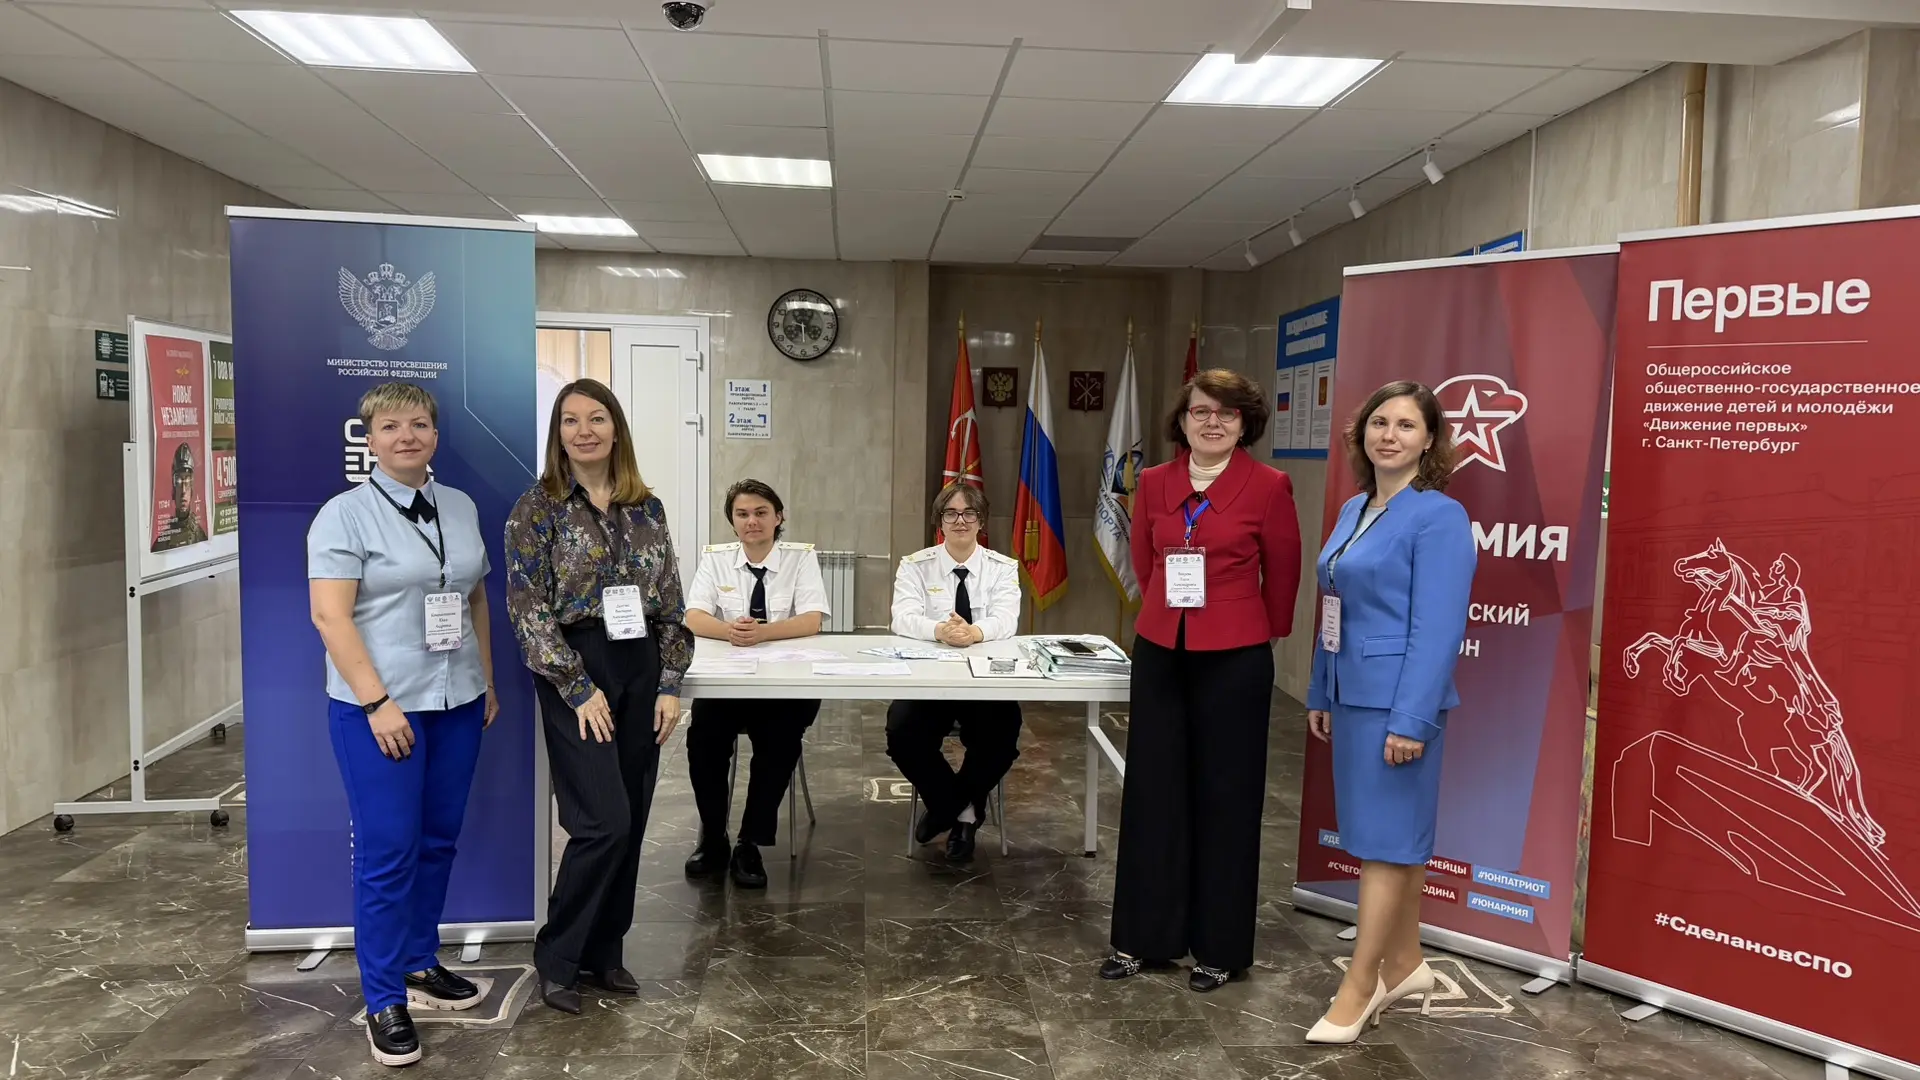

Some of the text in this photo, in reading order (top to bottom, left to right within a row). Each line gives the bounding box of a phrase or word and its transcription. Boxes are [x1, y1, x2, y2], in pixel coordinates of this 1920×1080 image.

[1648, 278, 1871, 333] Первые
[326, 358, 448, 370] МИНИСТЕРСТВО ПРОСВЕЩЕНИЯ
[1646, 361, 1792, 378] Общероссийское
[338, 368, 437, 379] РОССИЙСКОЙ ФЕДЕРАЦИИ
[729, 381, 733, 392] 1
[1645, 380, 1920, 397] общественно-государственное
[1643, 399, 1894, 416] движение детей и молодёжи
[729, 412, 735, 423] 2
[1643, 418, 1808, 434] «Движение первых»
[1641, 435, 1800, 453] г. Санкт-Петербург
[1097, 501, 1122, 541] ПОРТА
[1468, 603, 1530, 626] СКИЙ
[1327, 860, 1362, 876] #СЧЕГО
[1477, 871, 1546, 894] #ЮНПАТРИОТ
[1471, 896, 1529, 919] #ЮНАРМИЯ
[1654, 911, 1853, 979] #СделановСПО
